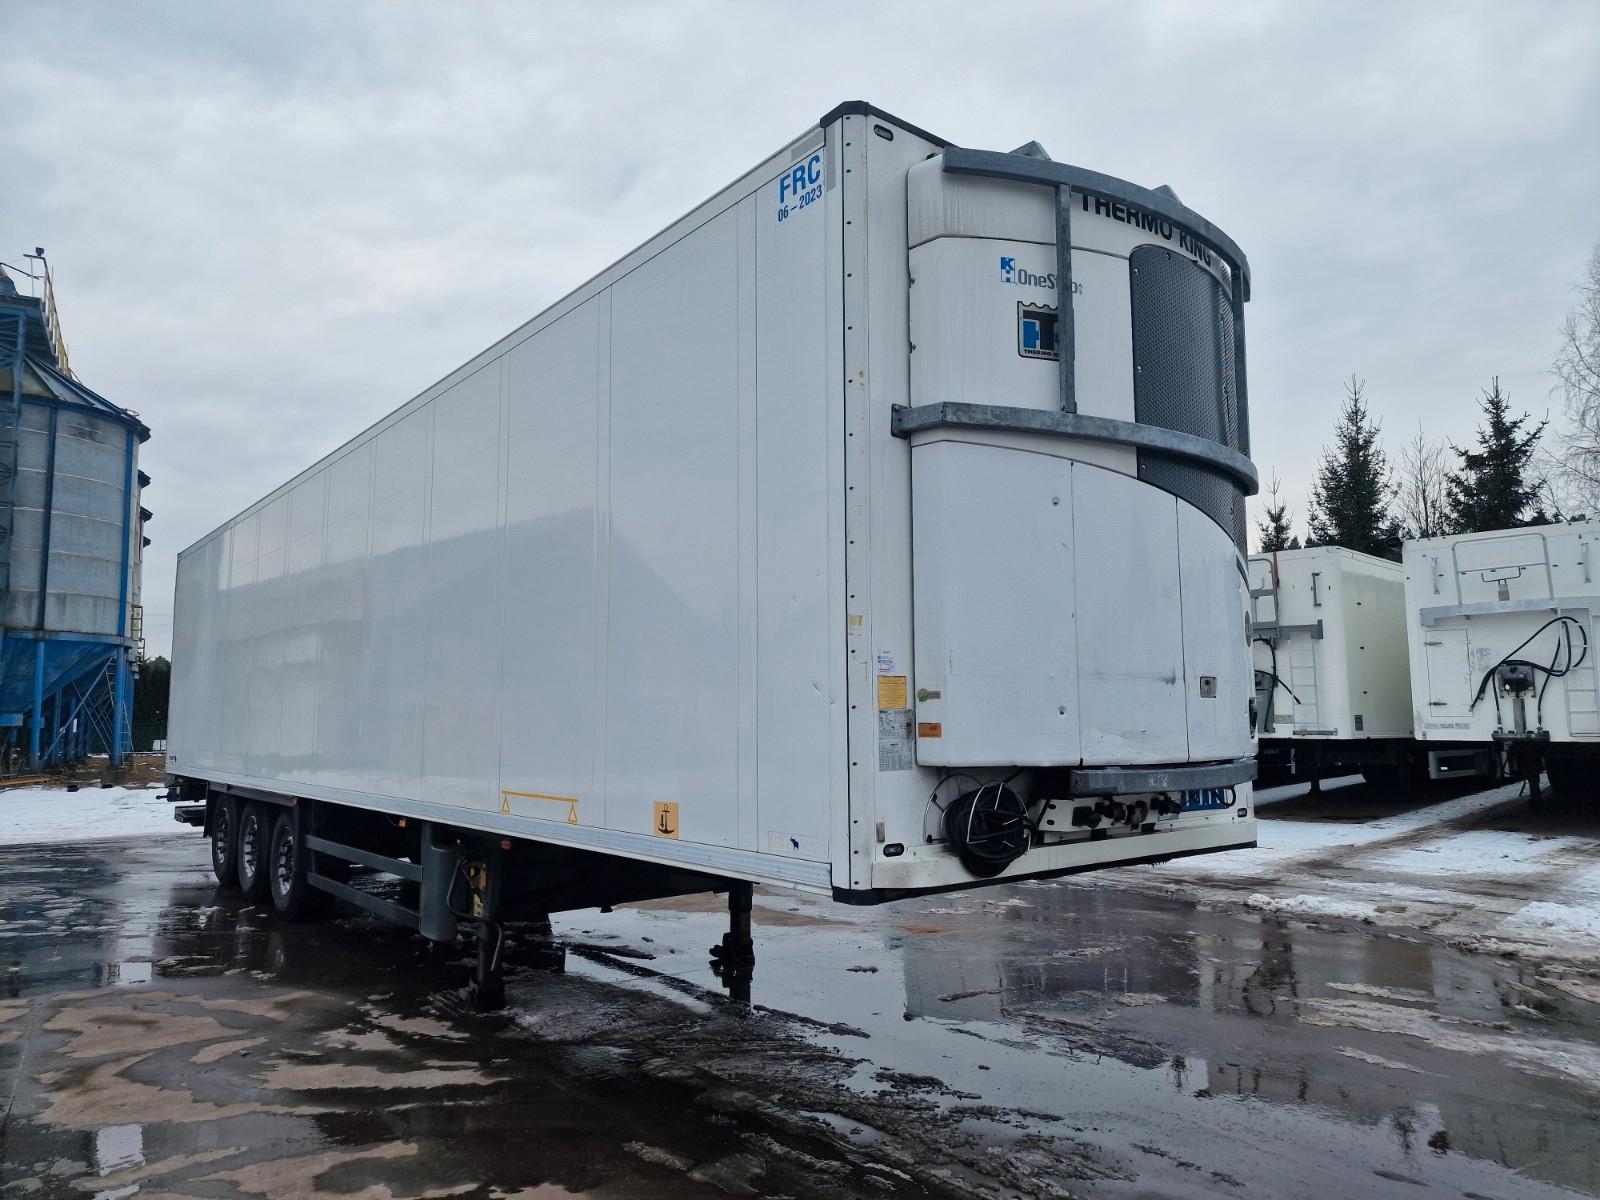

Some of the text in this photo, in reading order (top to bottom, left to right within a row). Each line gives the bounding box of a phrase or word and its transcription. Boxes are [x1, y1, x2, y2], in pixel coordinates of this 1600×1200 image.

[779, 154, 821, 204] FRC
[1081, 190, 1212, 268] THERMO KING
